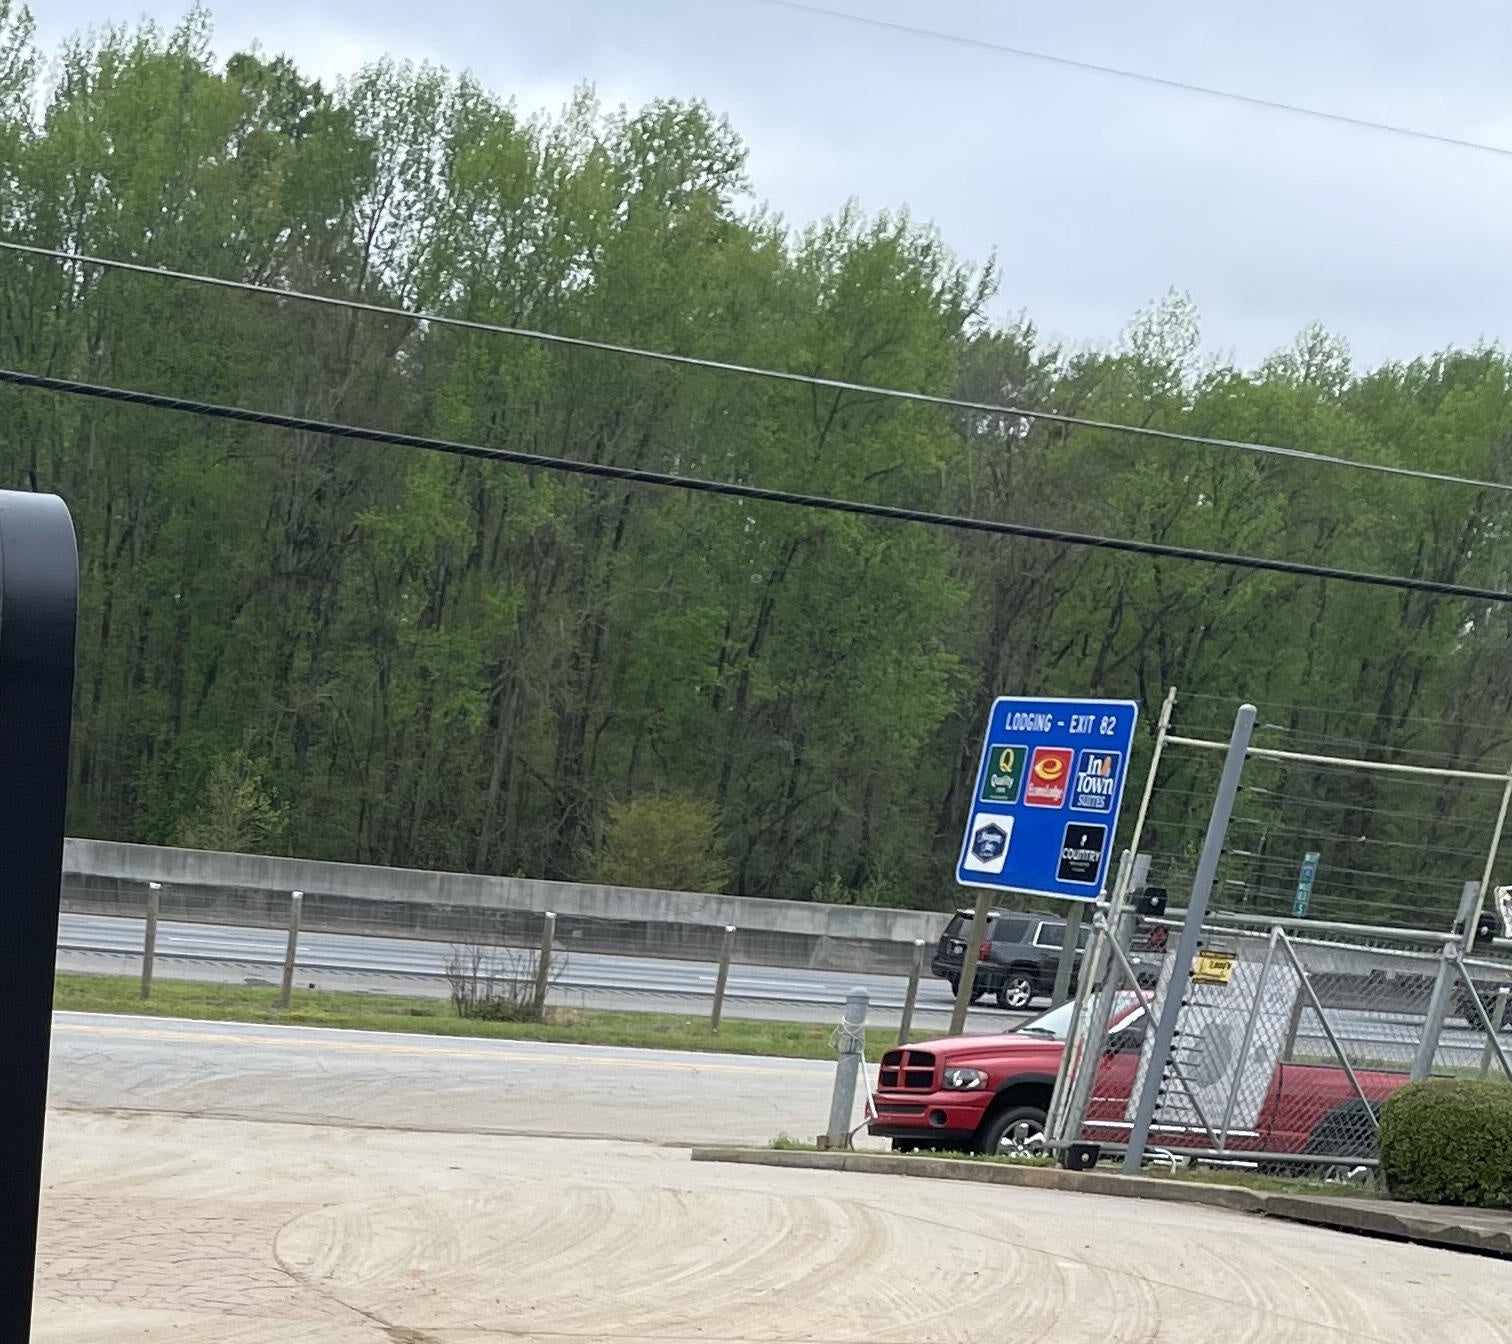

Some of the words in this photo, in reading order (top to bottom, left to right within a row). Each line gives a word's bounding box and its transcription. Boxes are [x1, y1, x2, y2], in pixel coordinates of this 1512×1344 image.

[1005, 712, 1053, 732] LODGING
[1069, 715, 1096, 734] EXIT
[1099, 716, 1117, 735] 82
[1086, 754, 1103, 776] In
[1076, 772, 1114, 795] Town
[1061, 847, 1101, 863] COUNTRY
